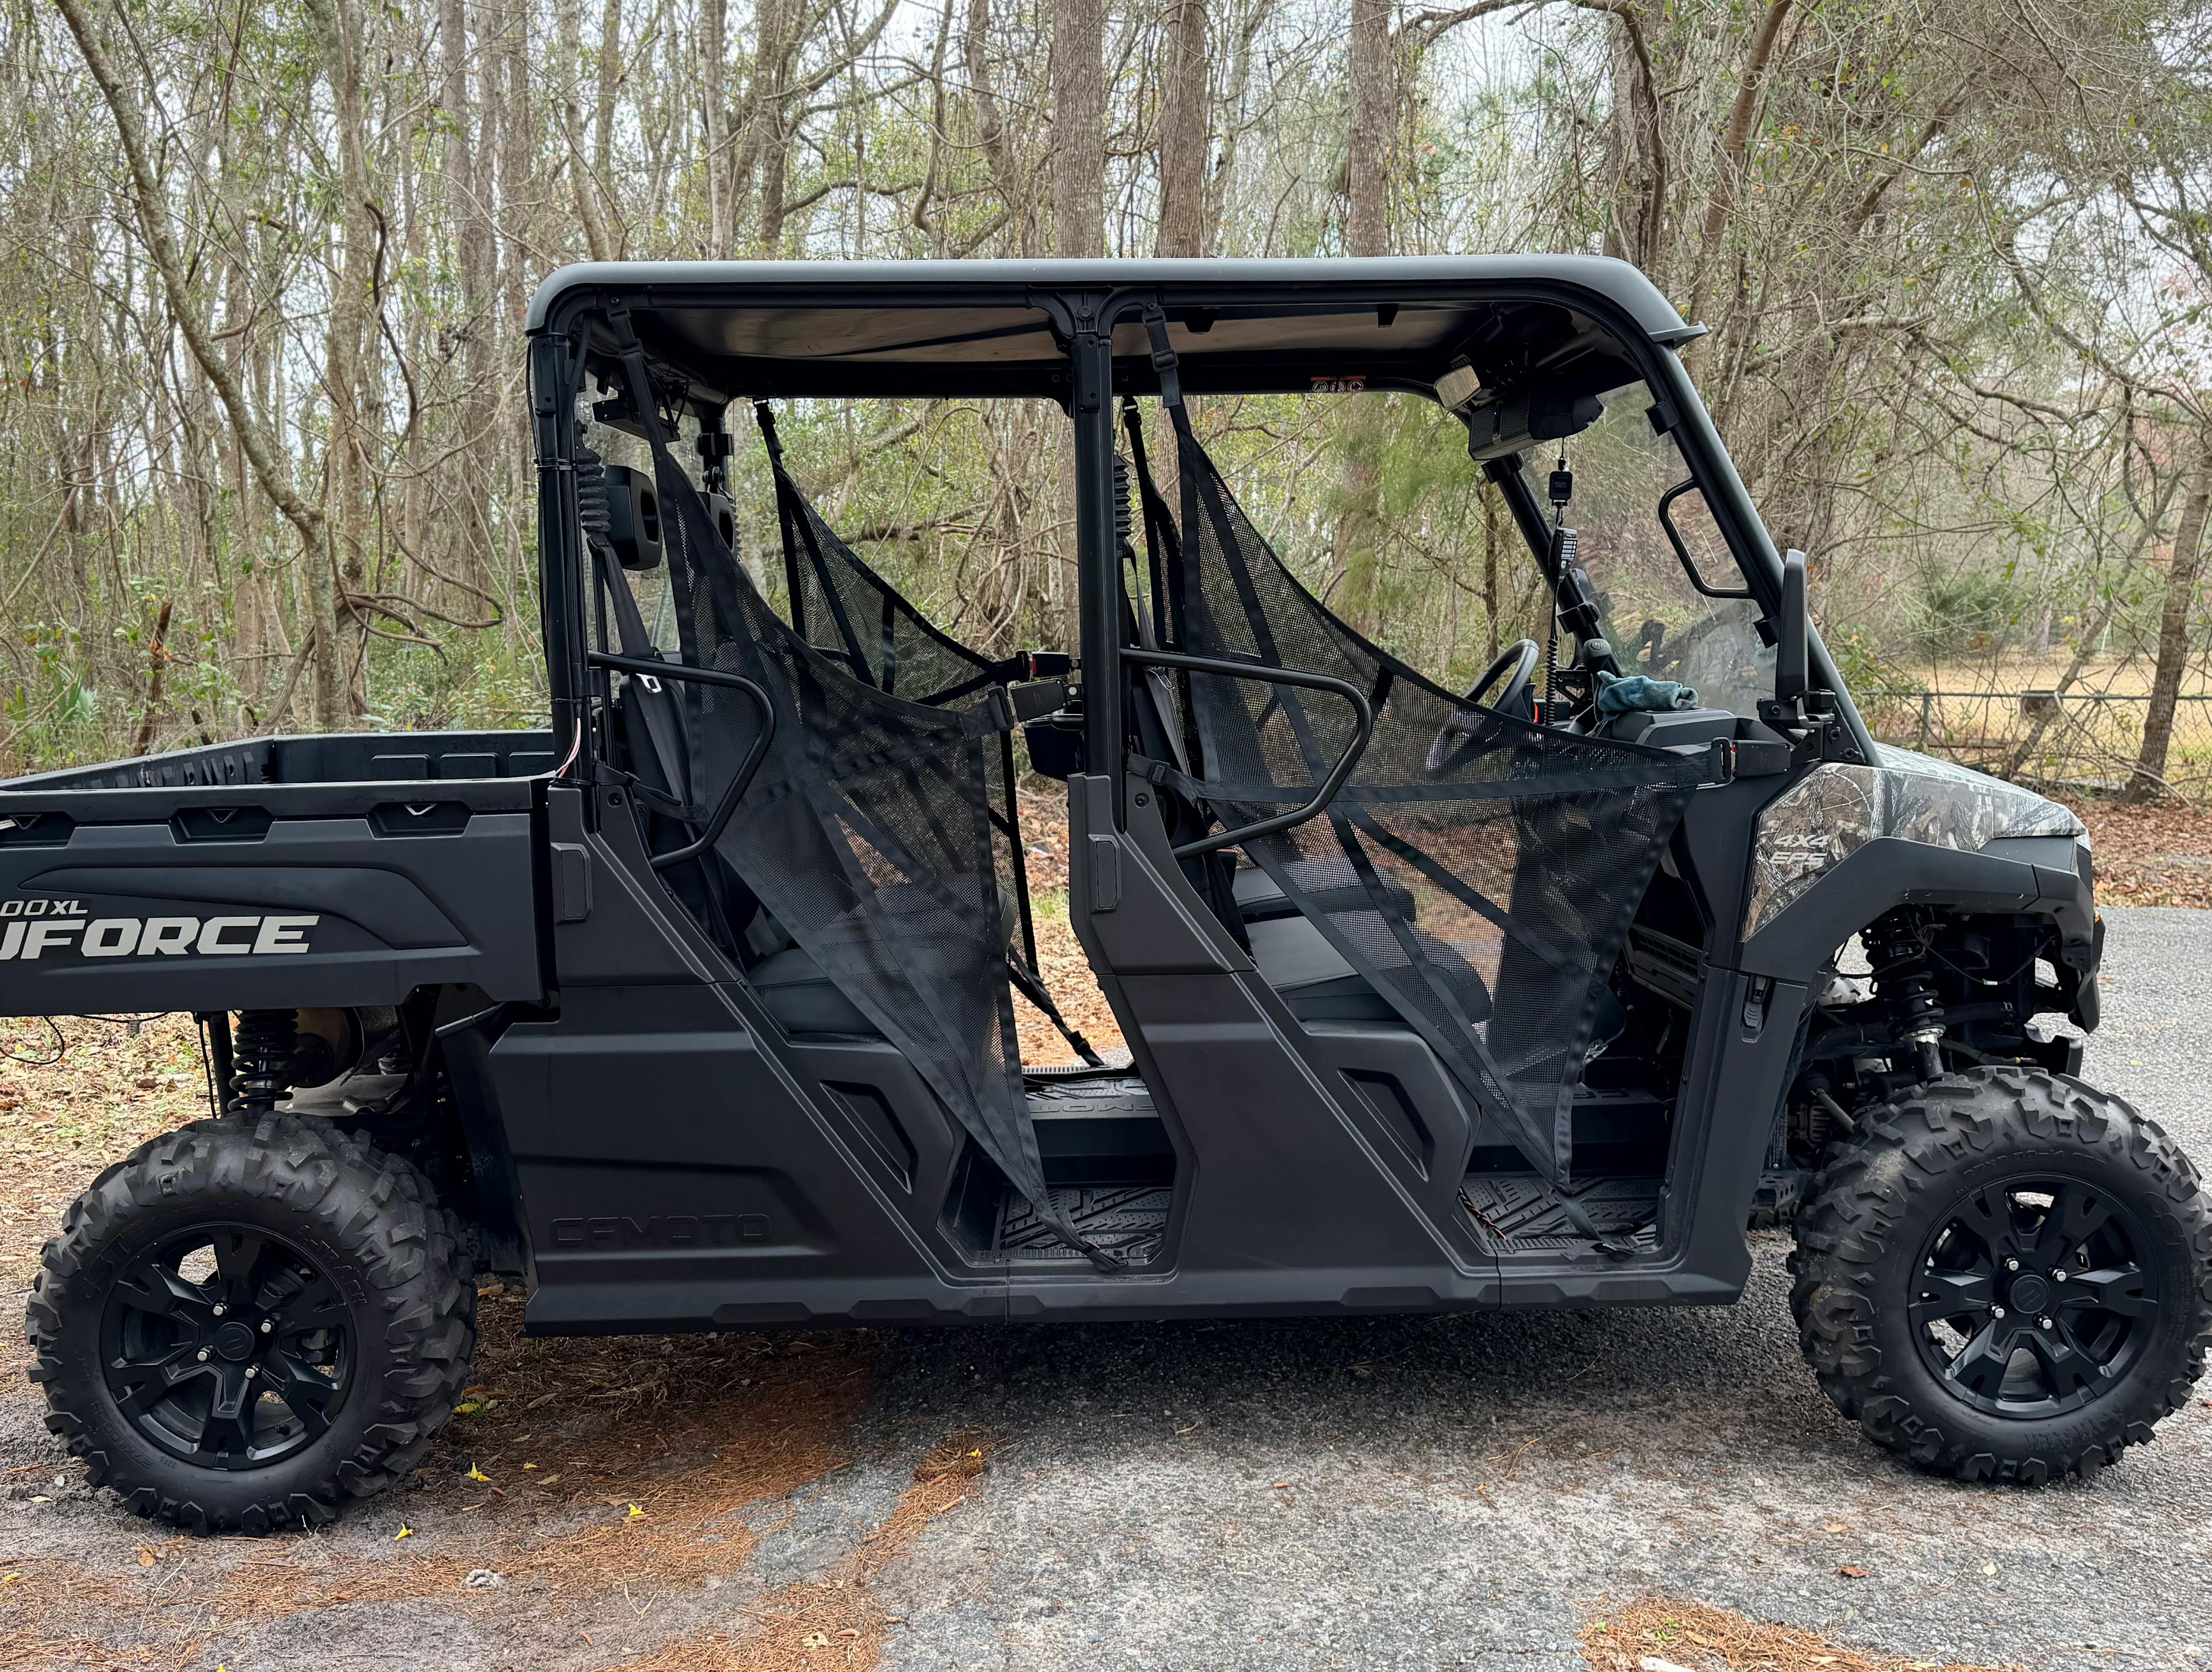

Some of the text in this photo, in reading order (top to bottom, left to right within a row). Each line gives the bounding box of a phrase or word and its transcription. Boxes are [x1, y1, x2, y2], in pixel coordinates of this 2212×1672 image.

[1774, 835, 1830, 849] 4X4
[1768, 852, 1827, 865] EPS
[551, 1214, 771, 1247] CFMOTO
